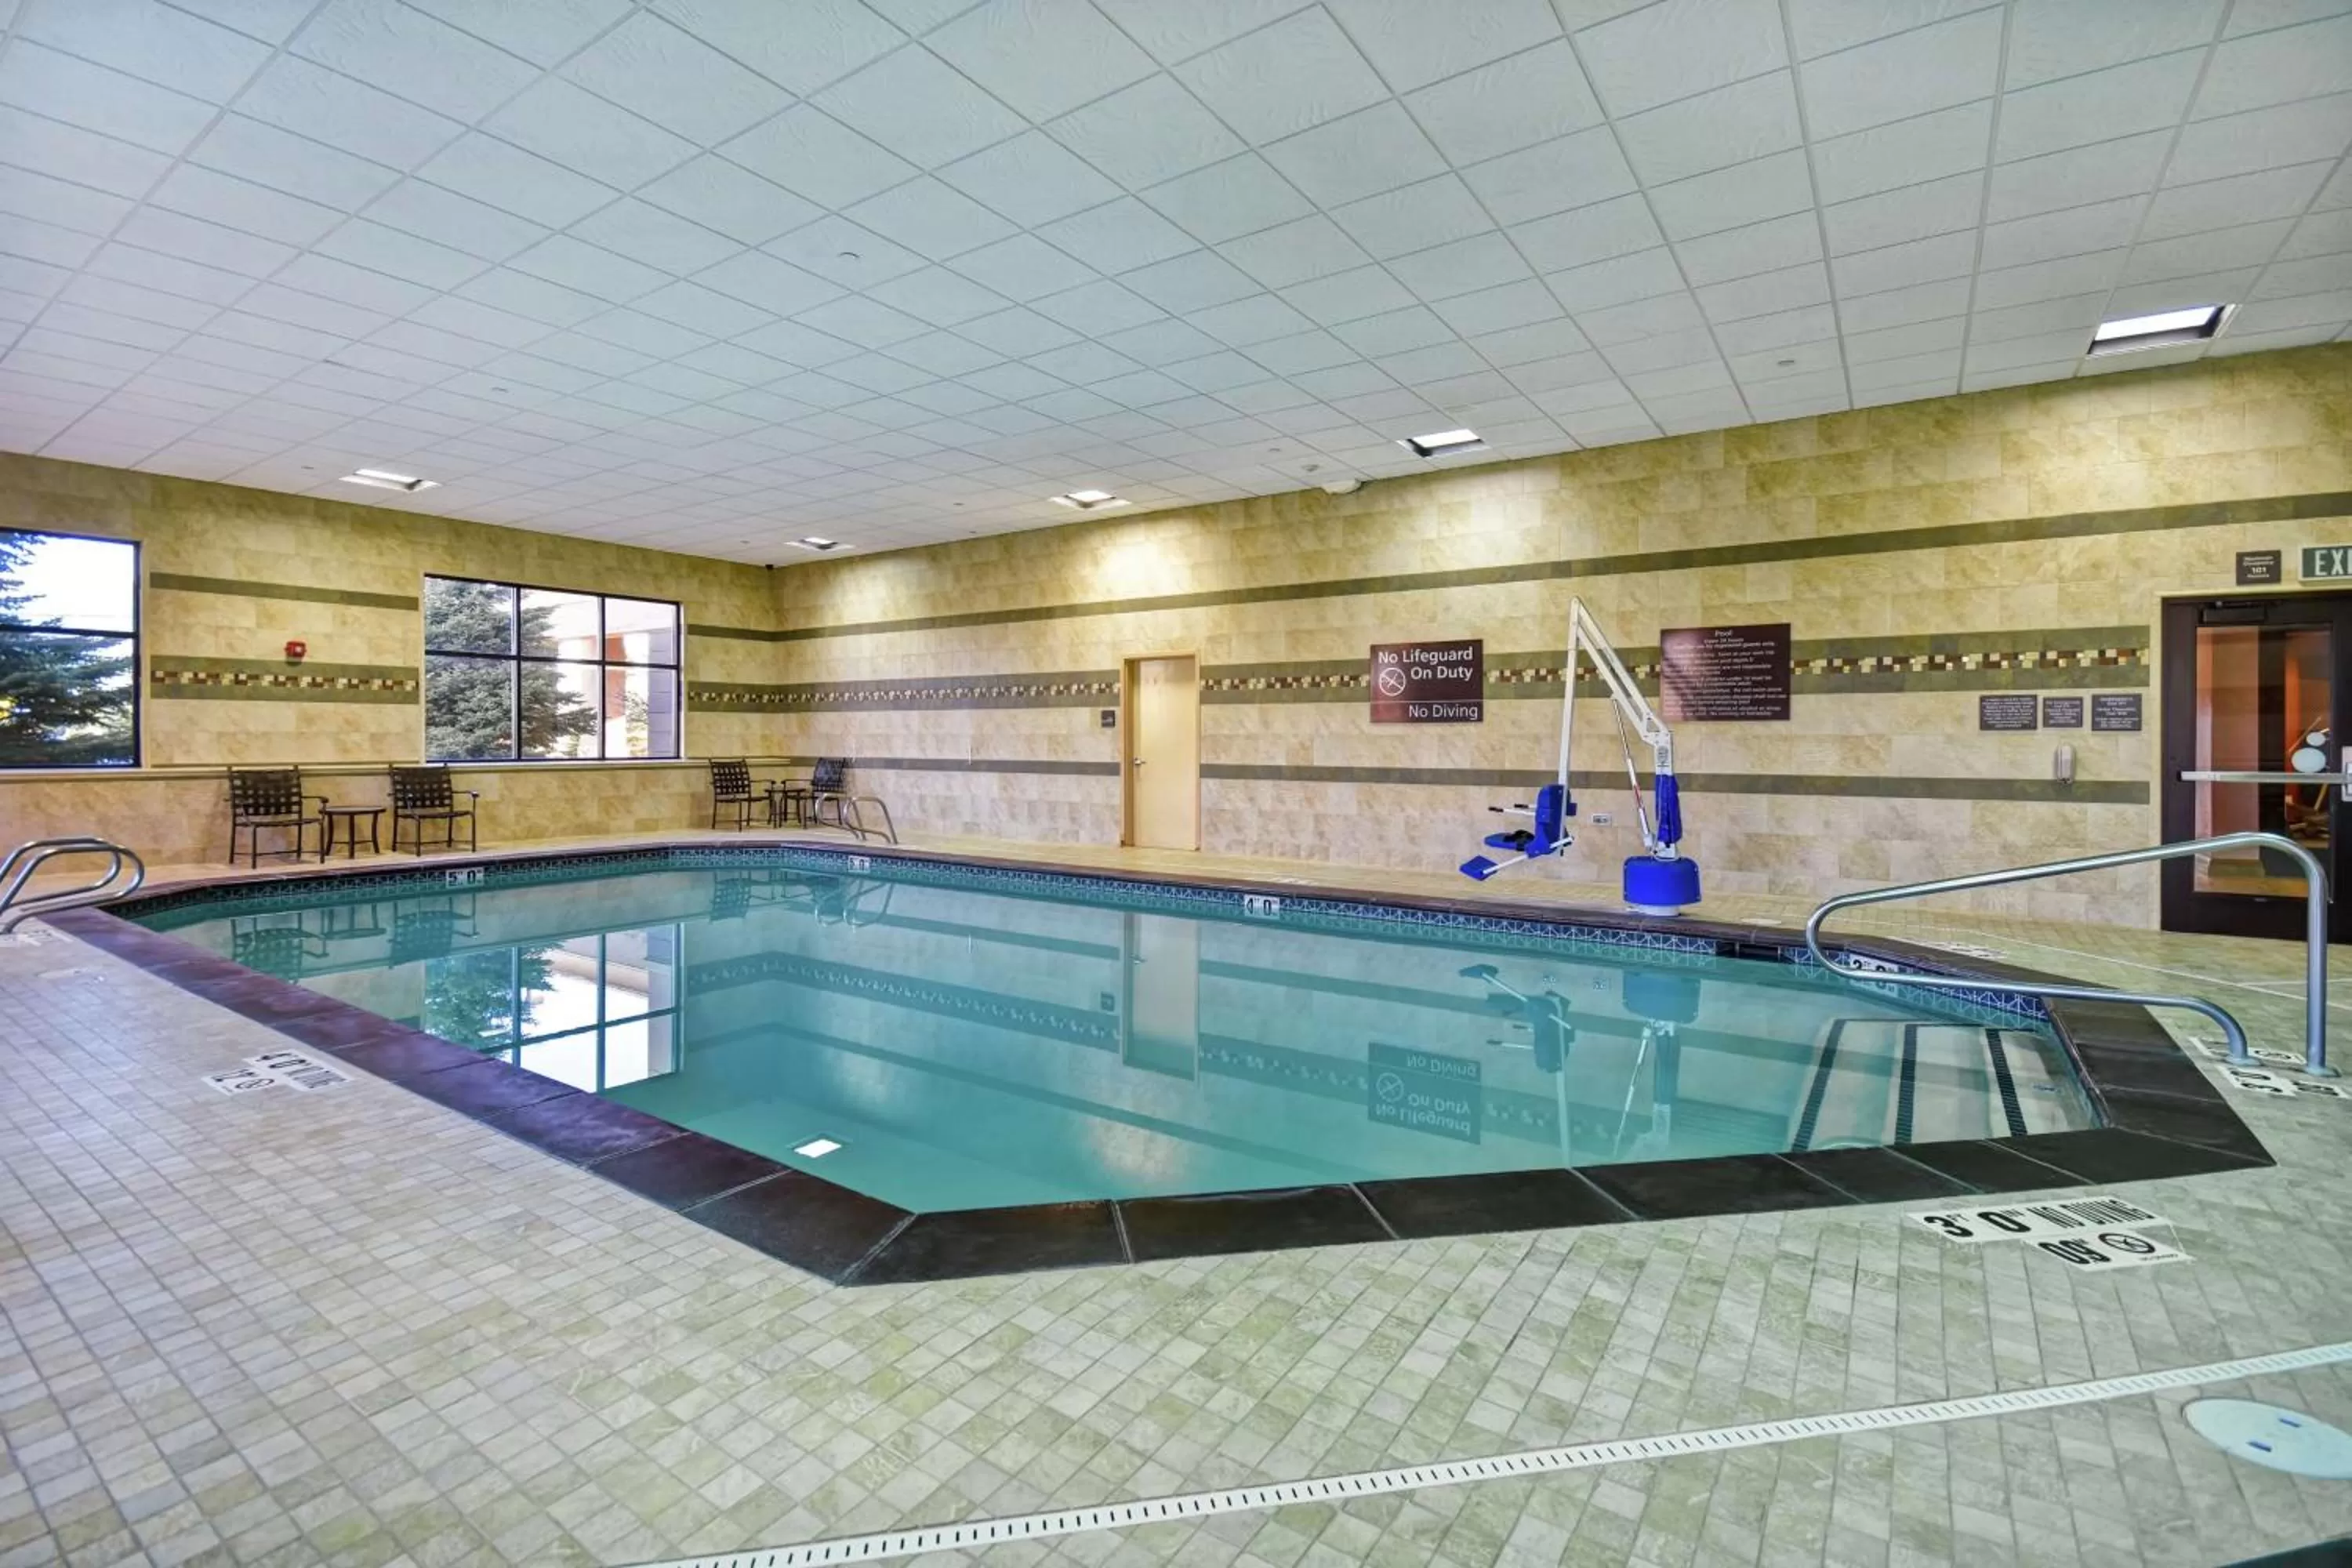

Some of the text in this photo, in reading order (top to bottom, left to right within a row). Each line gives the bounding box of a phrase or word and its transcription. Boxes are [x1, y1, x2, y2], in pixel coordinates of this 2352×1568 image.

[1378, 646, 1473, 665] No Lifeguard
[1411, 666, 1473, 681] On Duty
[1409, 704, 1478, 720] No Diving
[1923, 1216, 1973, 1237] 3
[1976, 1211, 2031, 1232] 0
